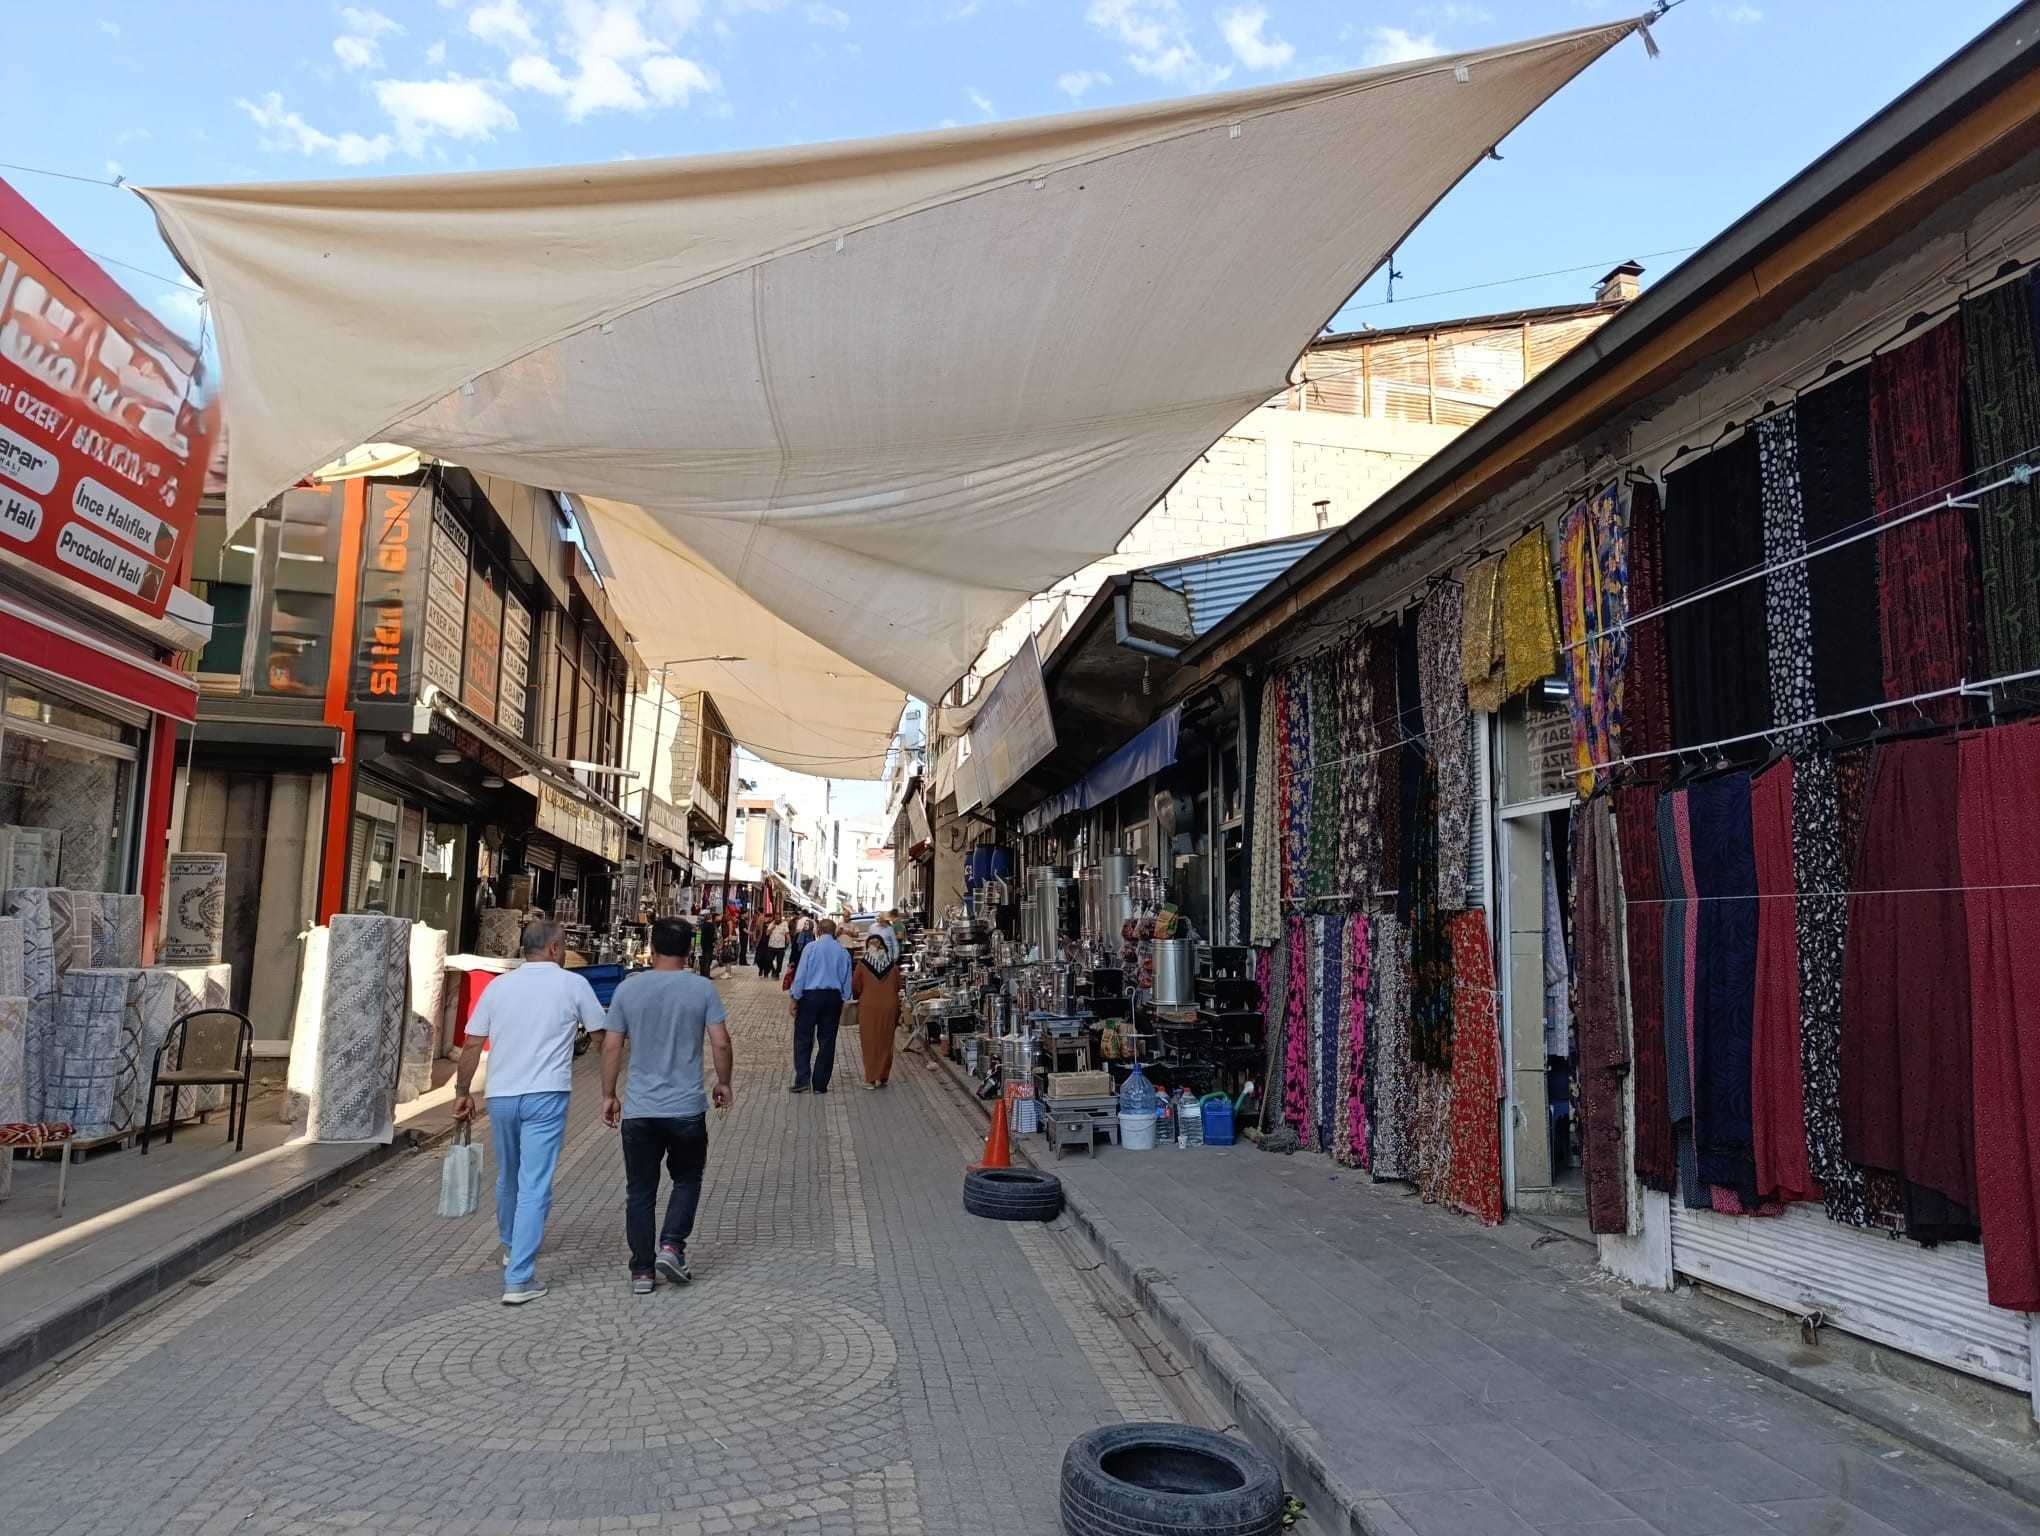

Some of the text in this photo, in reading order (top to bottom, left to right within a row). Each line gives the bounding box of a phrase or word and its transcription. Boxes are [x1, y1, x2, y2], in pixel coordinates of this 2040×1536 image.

[5, 499, 36, 530] Halı
[76, 484, 104, 517] İnce
[106, 504, 152, 544] Halıflex
[60, 530, 141, 585] Protokol Halı
[428, 659, 455, 691] SARAR
